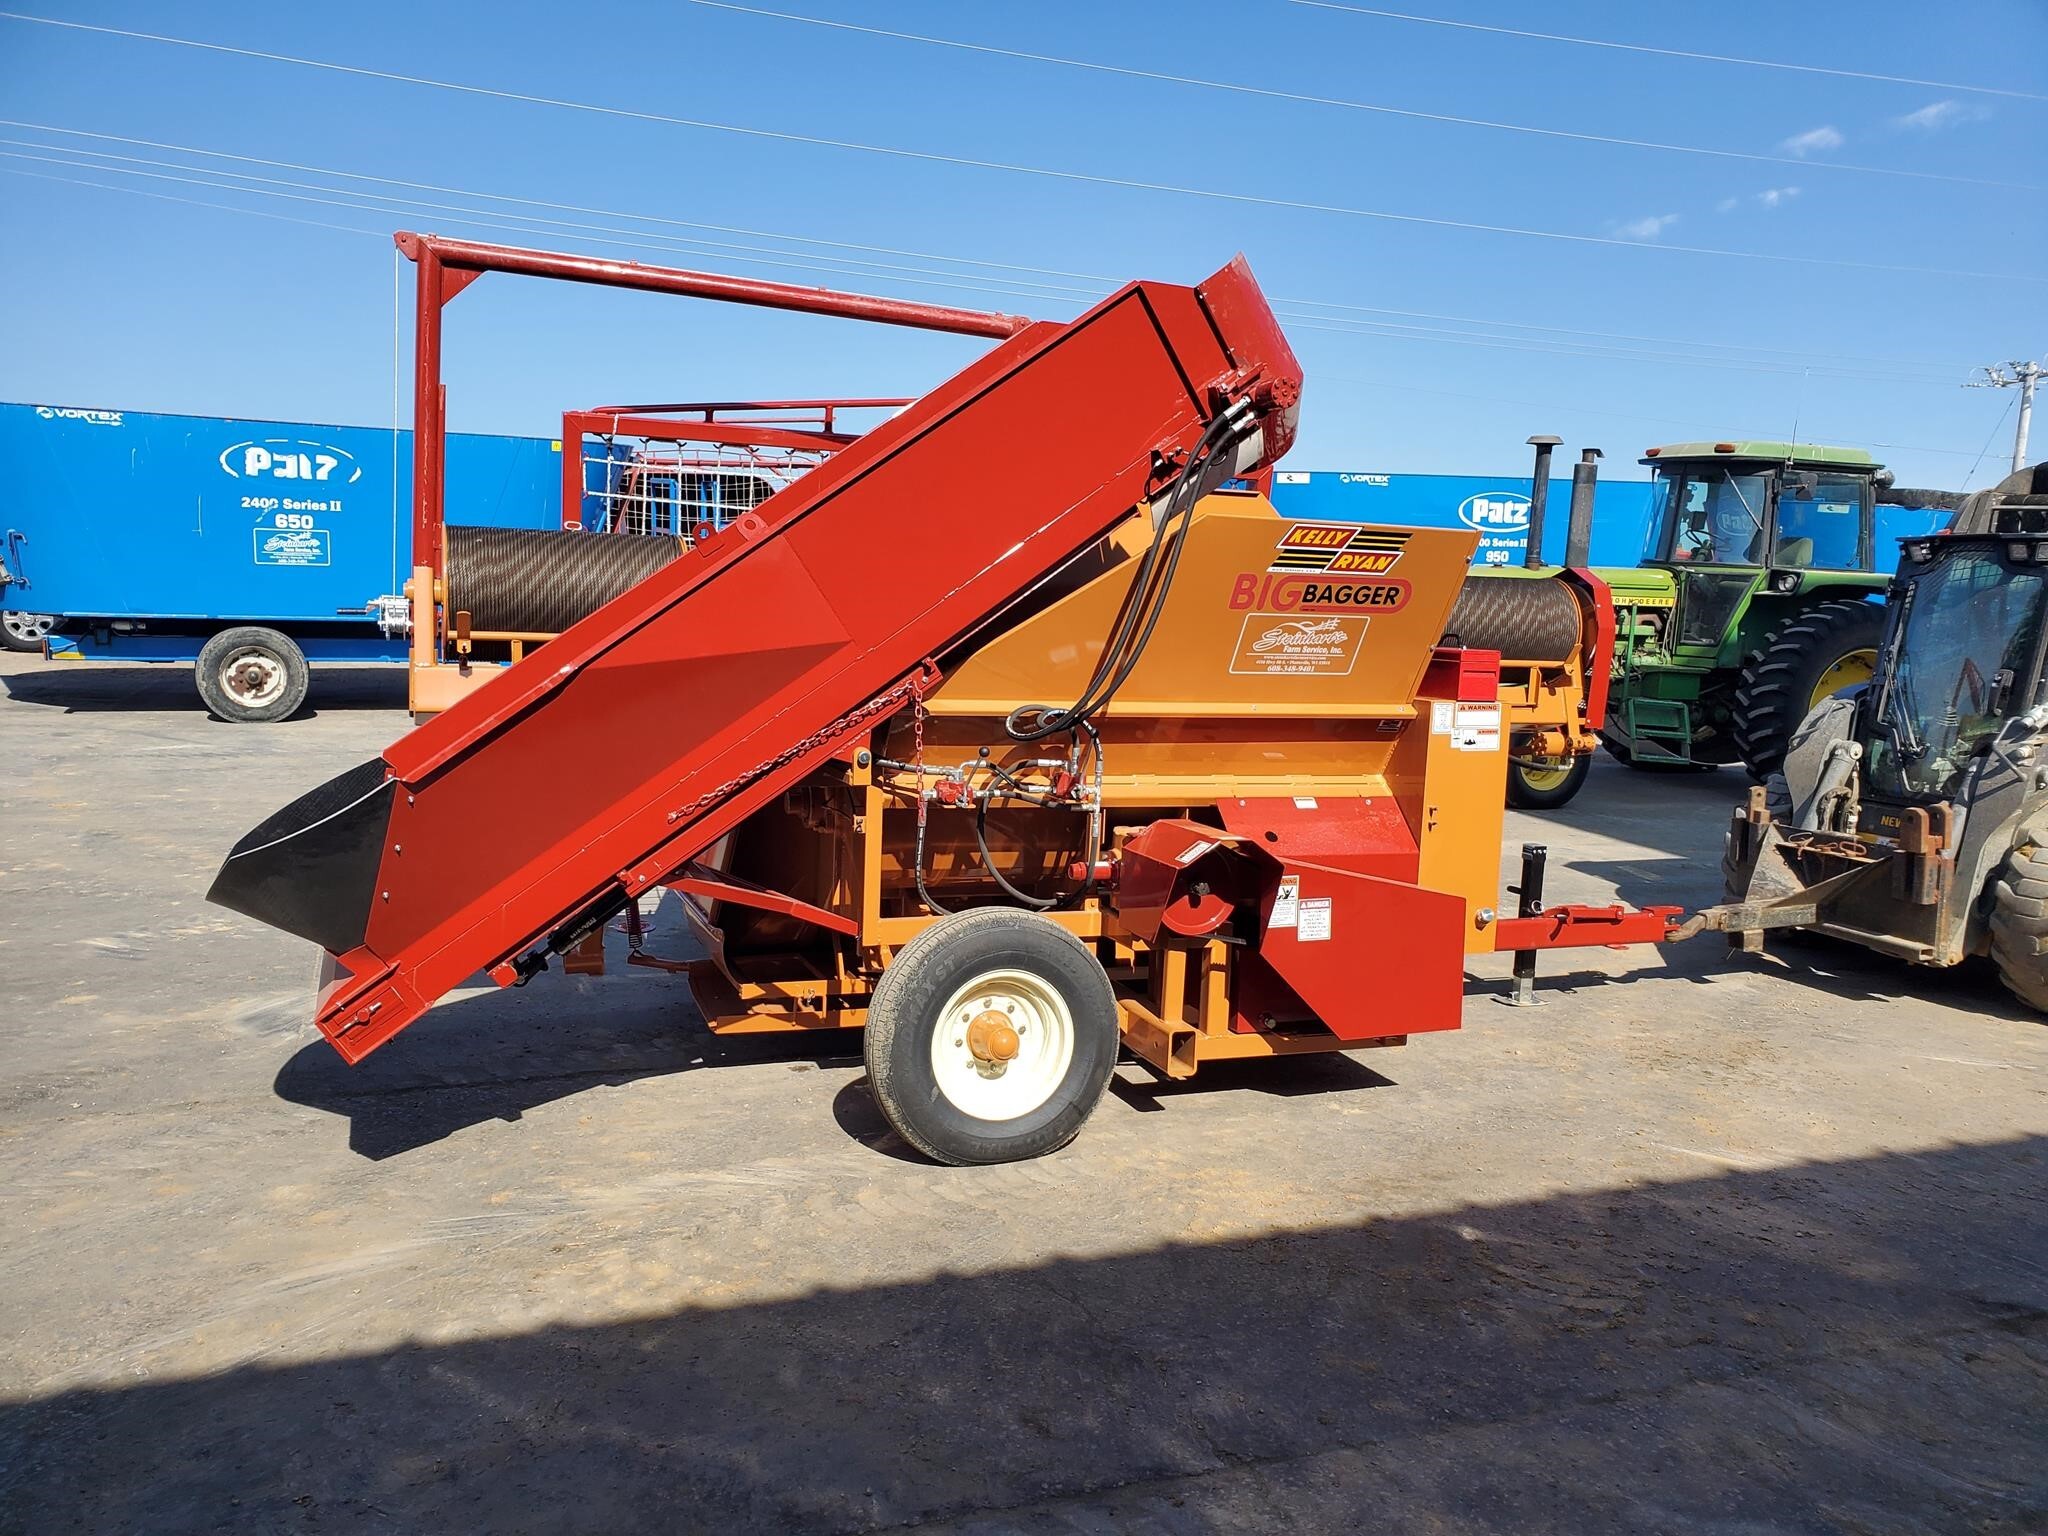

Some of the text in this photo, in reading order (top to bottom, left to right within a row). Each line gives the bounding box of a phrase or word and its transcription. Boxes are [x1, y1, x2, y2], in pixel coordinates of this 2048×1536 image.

[54, 408, 124, 422] VORTEX
[1350, 475, 1391, 483] VORTEX
[282, 498, 328, 511] Series
[329, 501, 342, 512] II
[1472, 498, 1528, 524] Patz
[274, 513, 314, 529] 650
[1287, 529, 1351, 546] KELLY
[1492, 537, 1519, 547] Series
[1333, 554, 1393, 571] RYAN
[1485, 550, 1510, 563] 950
[1228, 572, 1400, 612] BIG BAGGER
[1614, 597, 1670, 606] OHN DEERE
[1283, 645, 1343, 655] Farm Service, Inc.
